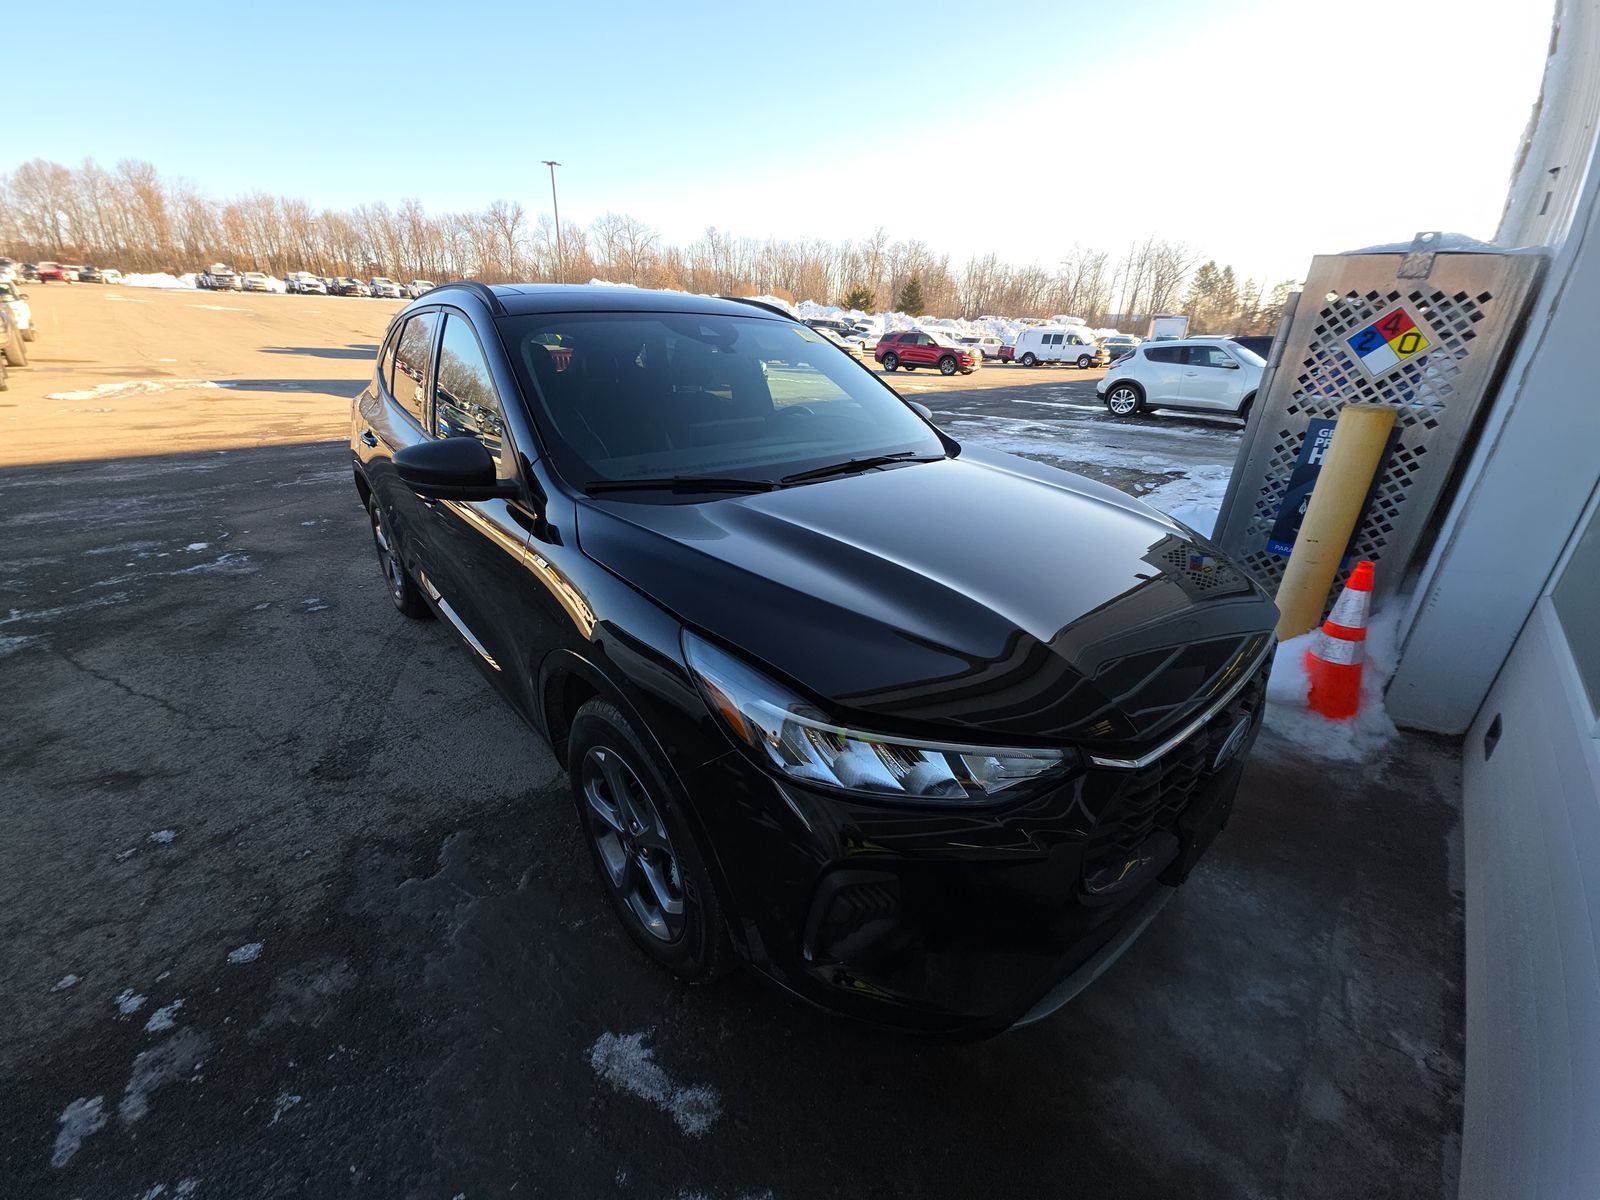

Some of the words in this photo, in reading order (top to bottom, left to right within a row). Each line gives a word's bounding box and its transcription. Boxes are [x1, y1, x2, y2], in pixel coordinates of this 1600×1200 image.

[1383, 313, 1403, 334] 4
[1358, 331, 1376, 351] 2
[1397, 332, 1422, 354] 0
